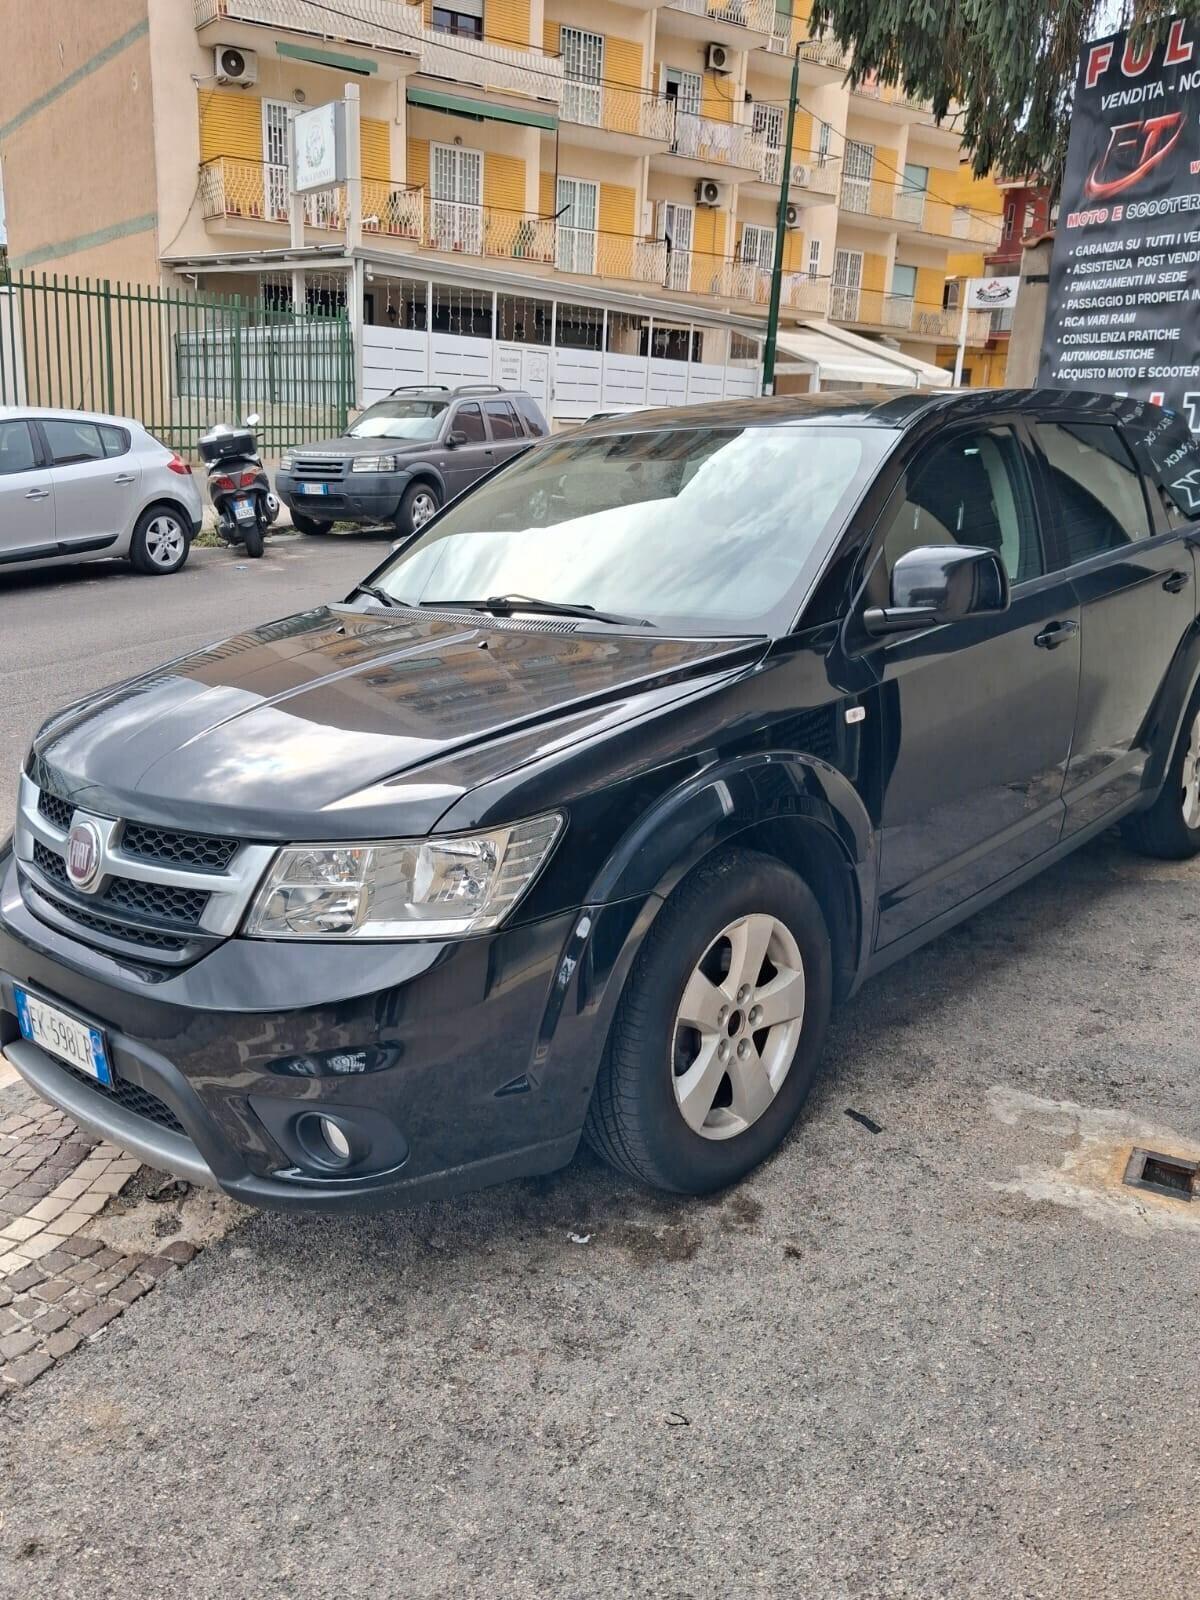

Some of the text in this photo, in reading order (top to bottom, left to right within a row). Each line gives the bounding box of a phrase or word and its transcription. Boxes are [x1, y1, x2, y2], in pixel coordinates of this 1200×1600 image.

[1101, 81, 1164, 111] VENDITA
[1066, 194, 1200, 229] MOTO E SCOOTER
[1075, 240, 1124, 257] GARANZIA
[1125, 238, 1141, 250] SU
[1145, 233, 1175, 248] TUTTI
[1073, 258, 1133, 275] ASSISTENZA
[1137, 254, 1166, 268] POST
[1070, 270, 1188, 292] FINANZIAMENTI IN SEDE
[1066, 295, 1123, 310] PASSAGGIO
[1125, 294, 1136, 306] DI
[1137, 290, 1190, 305] PROPIETA
[1064, 312, 1136, 327] RCA VARI RAMI
[1062, 328, 1181, 345] CONSULENZA PRATICHE
[1059, 348, 1155, 362] AUTOMOBILISTICHE
[1057, 365, 1200, 381] ACQUISTO MOTO E SCOOTER
[69, 838, 91, 871] FIAT
